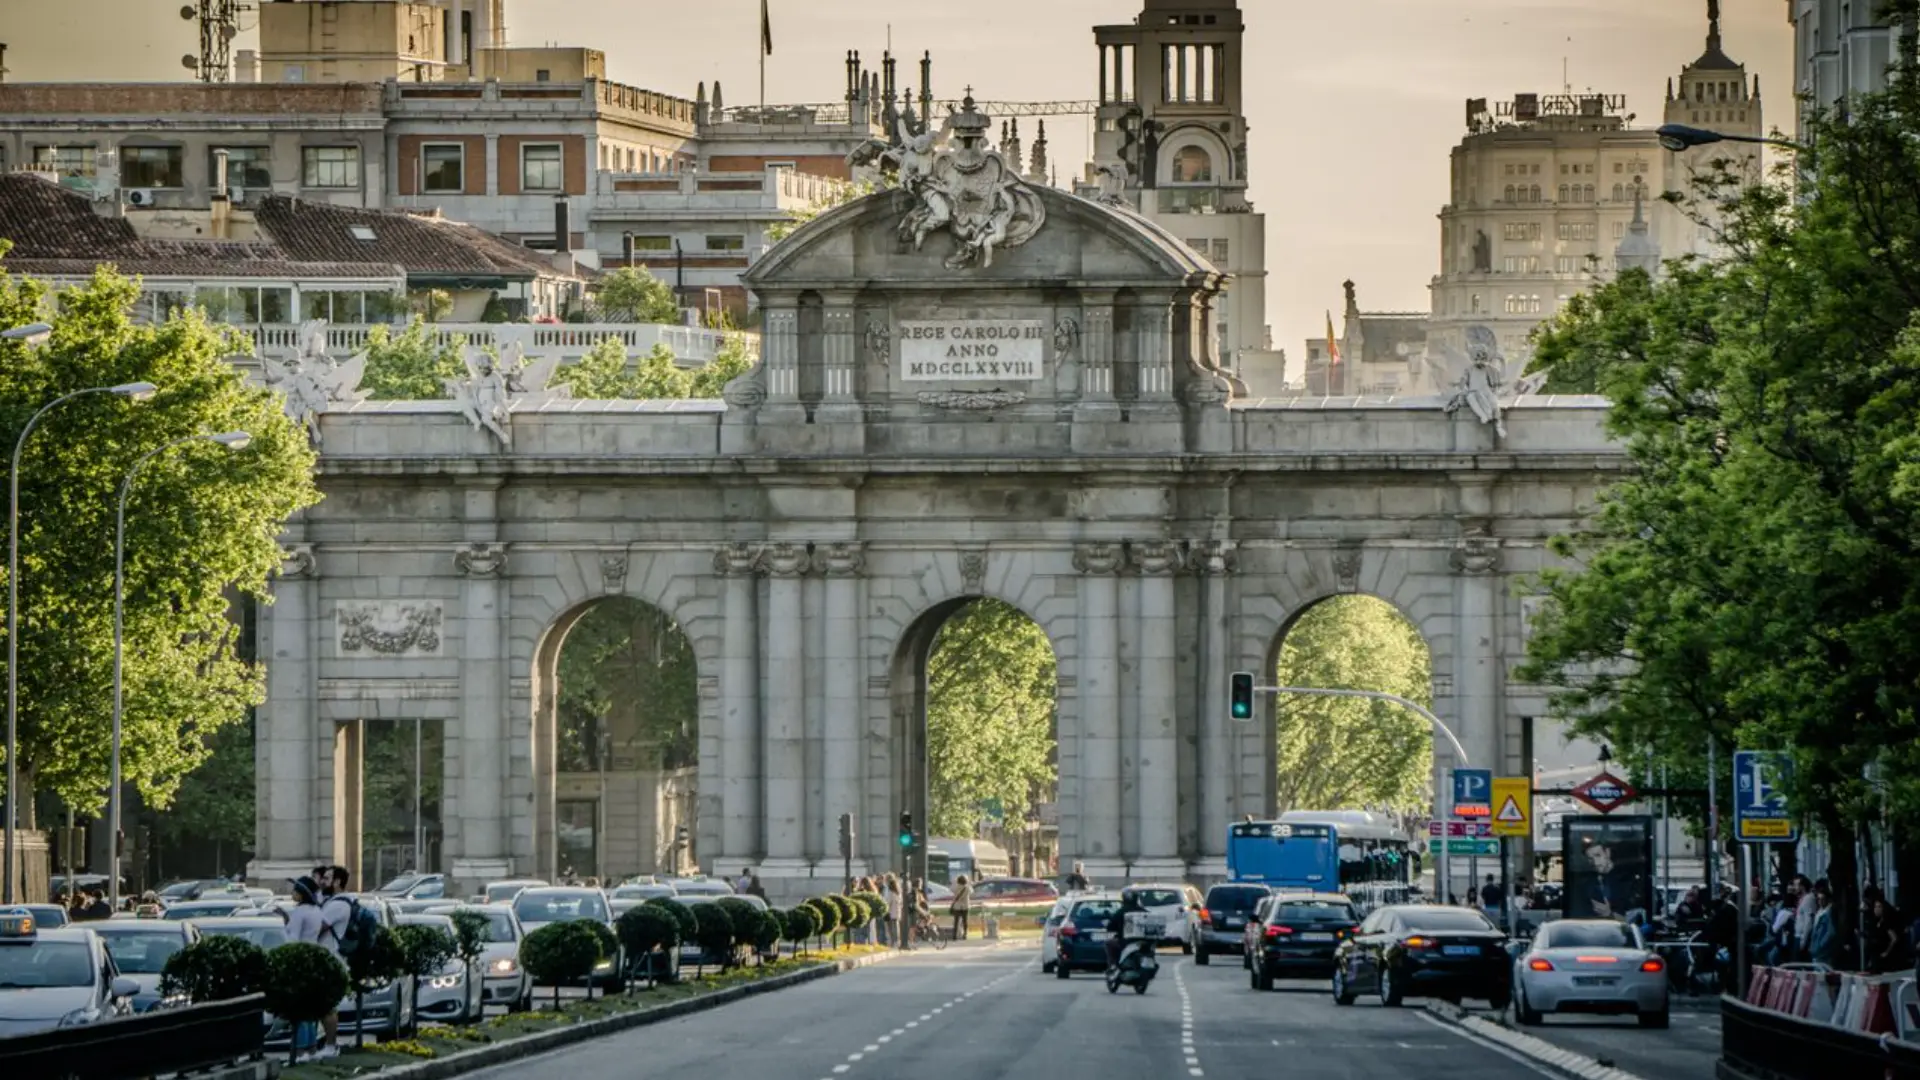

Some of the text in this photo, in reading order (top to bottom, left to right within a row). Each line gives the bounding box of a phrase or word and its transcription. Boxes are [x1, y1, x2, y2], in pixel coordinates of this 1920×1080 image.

[900, 326, 1043, 340] REGE CAROLO III
[944, 344, 999, 357] ANNO
[910, 362, 1033, 375] MDCCLXXVIII
[1463, 775, 1485, 798] P
[1590, 787, 1620, 797] Metro
